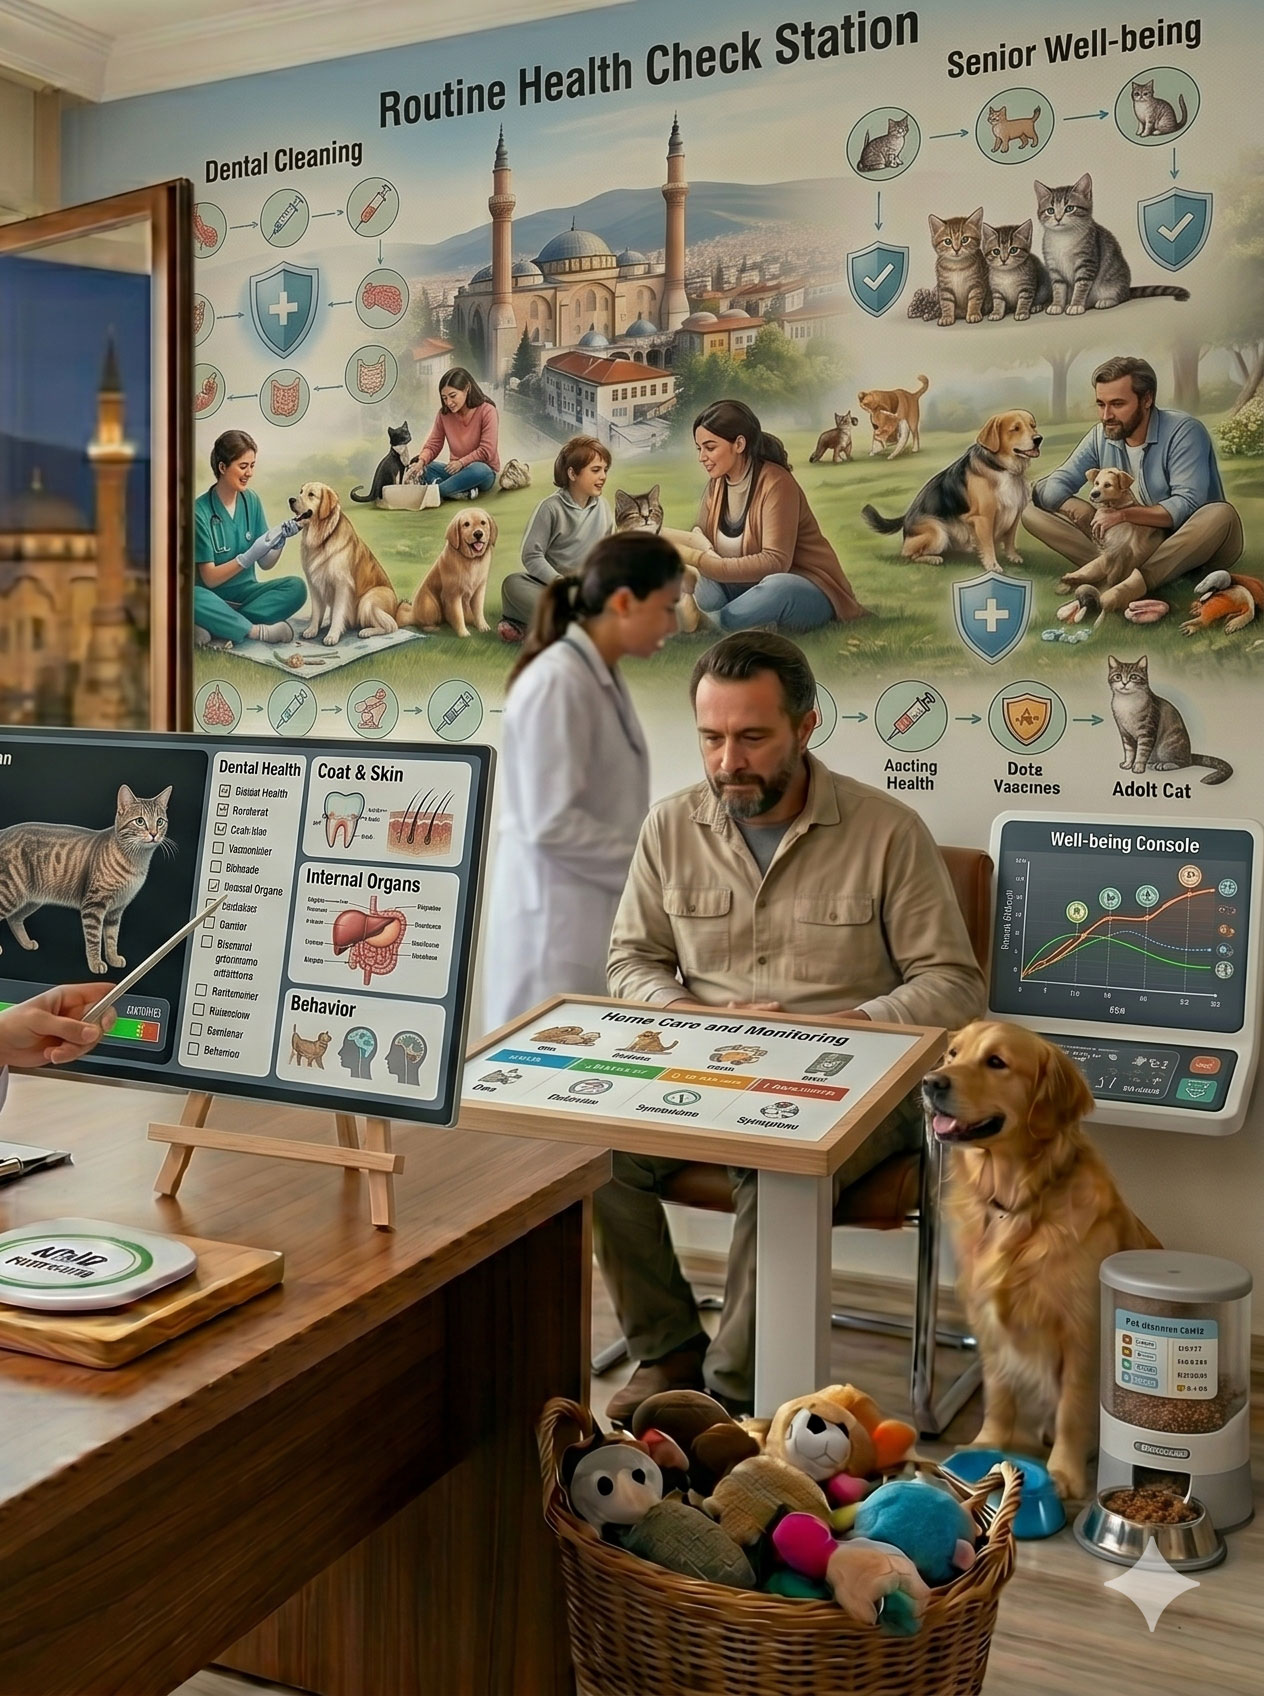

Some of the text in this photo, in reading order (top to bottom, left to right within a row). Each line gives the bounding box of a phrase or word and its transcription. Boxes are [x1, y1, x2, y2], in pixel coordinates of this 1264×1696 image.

[948, 18, 1201, 78] Senior Well-being
[380, 9, 920, 128] Routine Health Check Station
[206, 140, 362, 183] Dental Cleaning
[219, 760, 301, 776] Dental Health
[318, 763, 404, 782] Coat & Skin
[262, 789, 288, 798] Health
[887, 776, 934, 791] Health
[1112, 782, 1191, 799] Adolt Cat
[1051, 831, 1199, 853] Well-being Console
[306, 868, 421, 894] Internal Organs
[290, 995, 356, 1018] Behavior
[602, 1012, 655, 1025] Home
[705, 1023, 743, 1034] and
[744, 1026, 849, 1046] Monitoring
